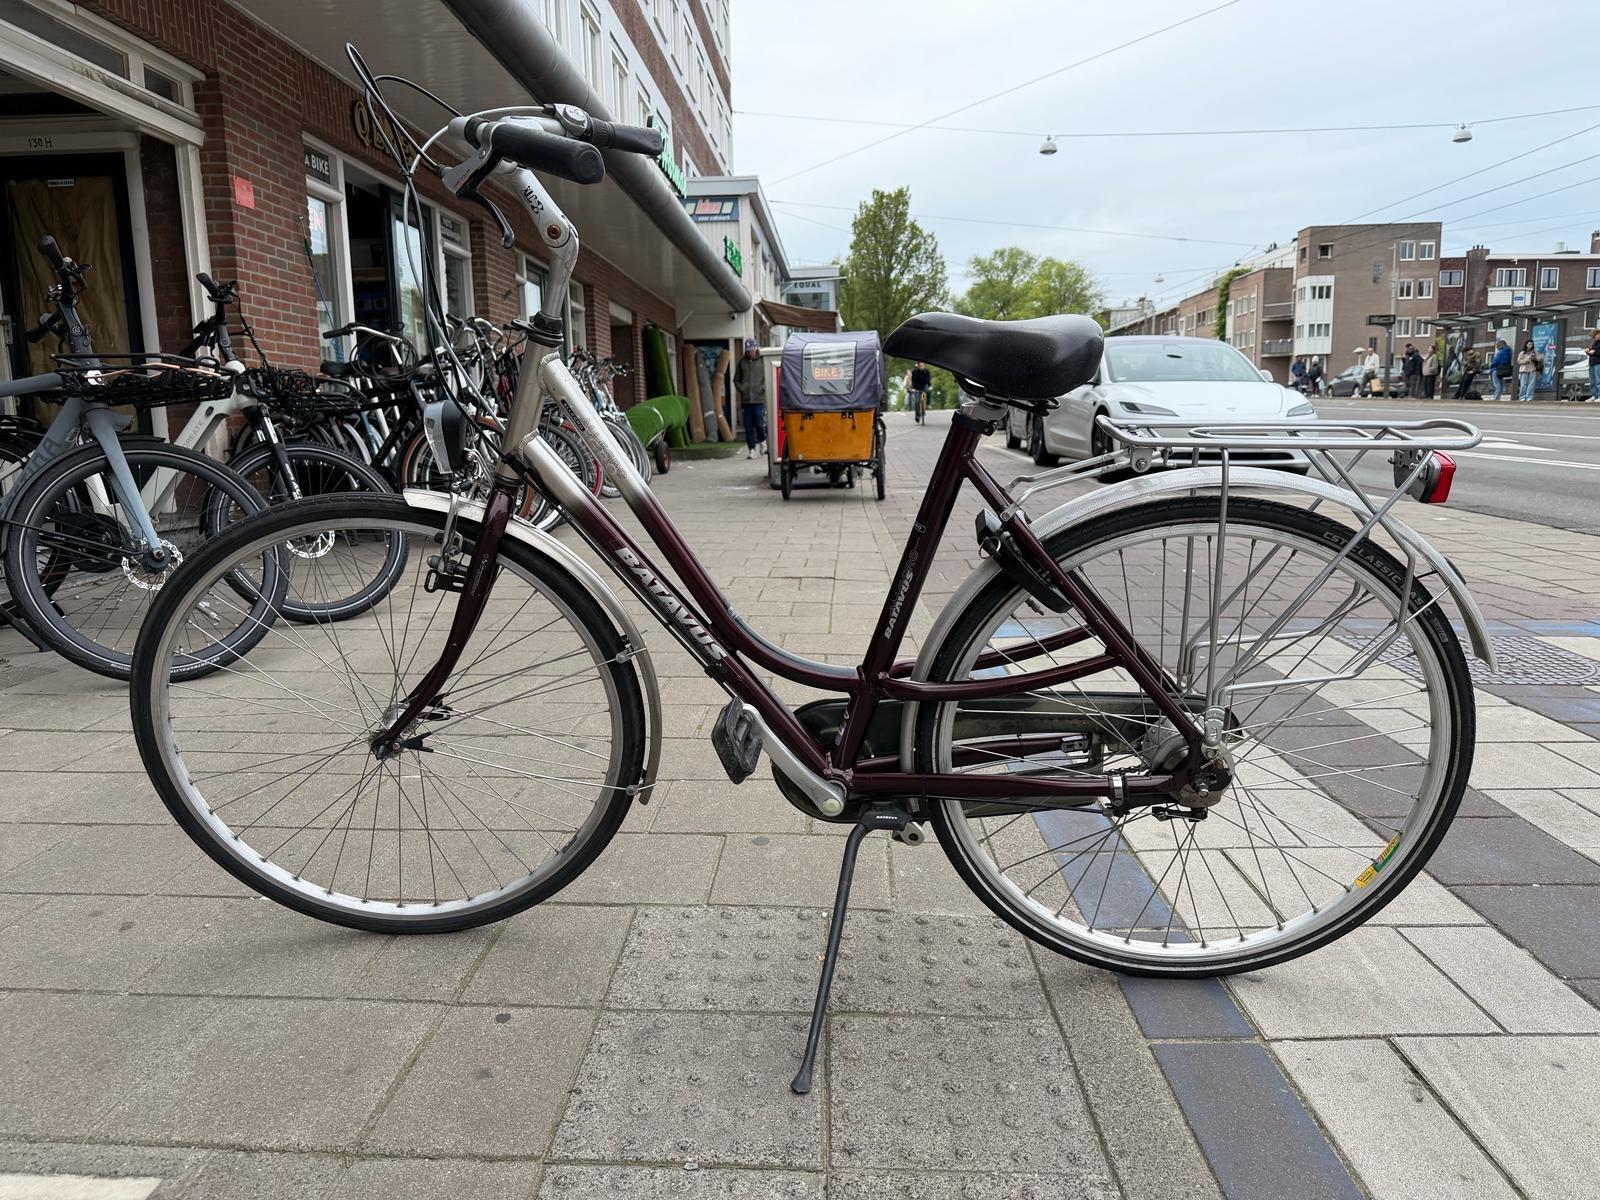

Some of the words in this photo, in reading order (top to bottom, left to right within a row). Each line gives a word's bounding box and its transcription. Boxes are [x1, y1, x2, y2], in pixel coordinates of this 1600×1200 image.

[28, 137, 43, 148] 130
[45, 136, 52, 148] H
[311, 154, 330, 175] BIKE
[814, 367, 838, 377] BIKE
[615, 547, 727, 661] BATAVUS
[884, 570, 914, 639] BATAVUS
